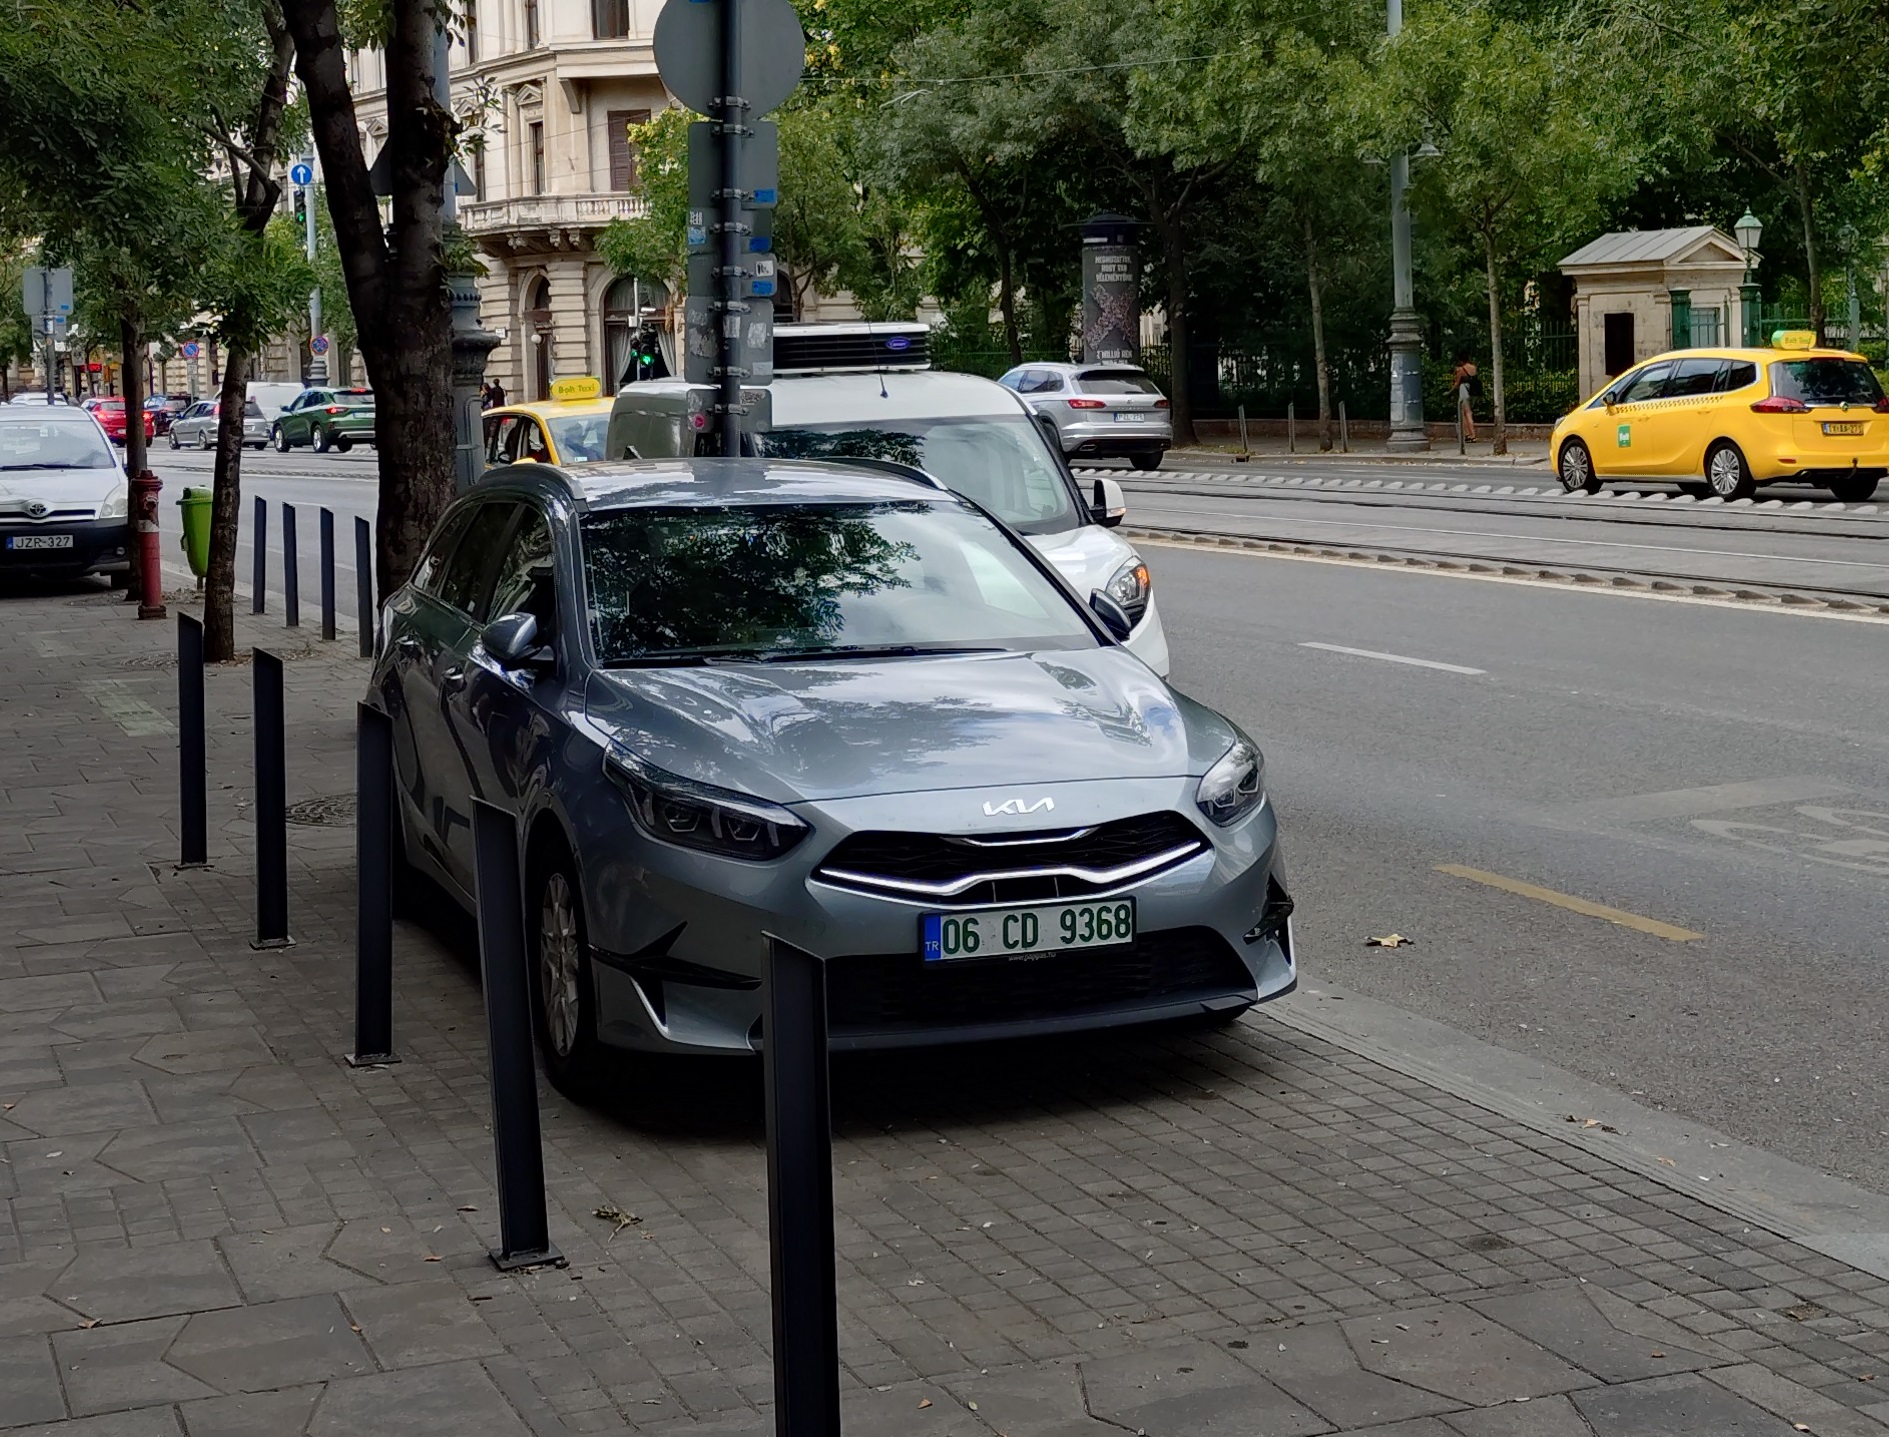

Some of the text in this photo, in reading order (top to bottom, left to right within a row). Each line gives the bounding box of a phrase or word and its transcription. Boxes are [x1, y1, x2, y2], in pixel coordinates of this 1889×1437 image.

[16, 536, 70, 548] JZR-327
[982, 796, 1055, 816] KIA
[925, 903, 1132, 955] TR 06 CD 9368
